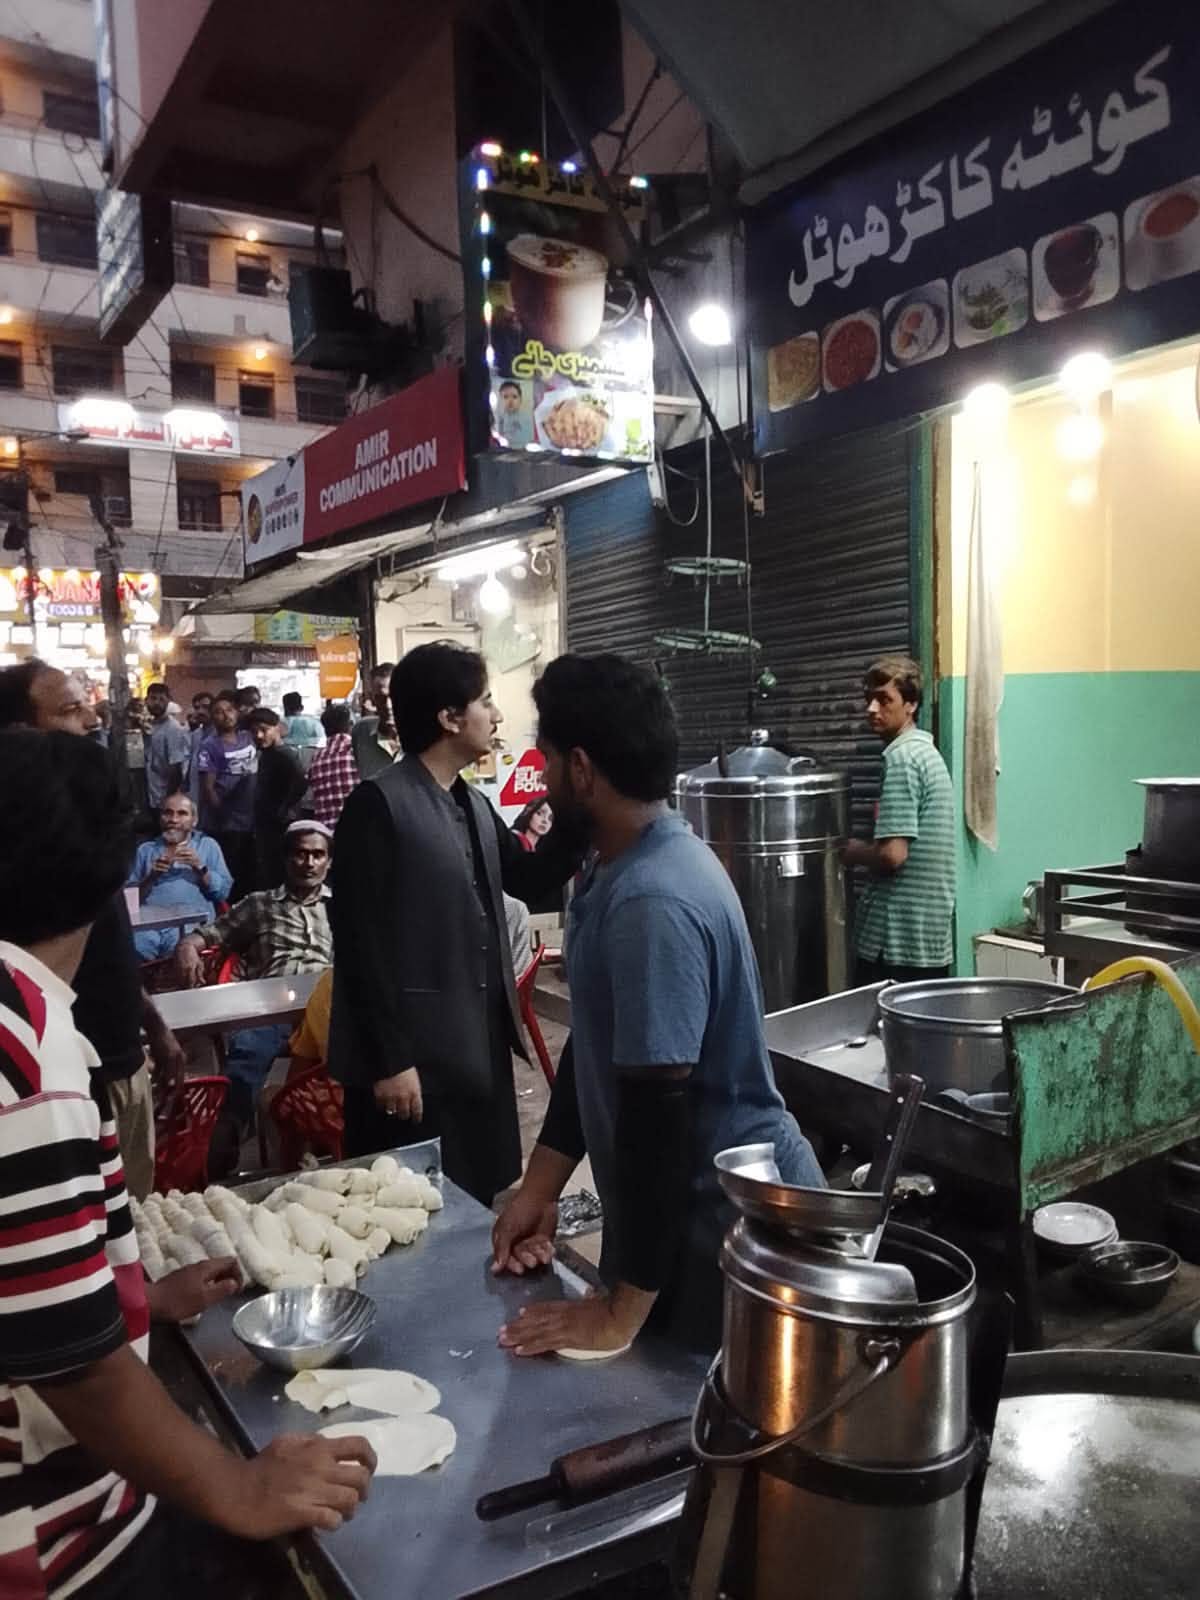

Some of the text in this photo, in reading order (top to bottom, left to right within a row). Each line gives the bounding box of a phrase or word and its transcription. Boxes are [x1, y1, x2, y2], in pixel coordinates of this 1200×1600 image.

[1001, 44, 1172, 191] کوئٹہ
[889, 136, 994, 264] کاکڑ
[319, 437, 438, 513] COMMUNICATION
[354, 428, 390, 470] AMIR
